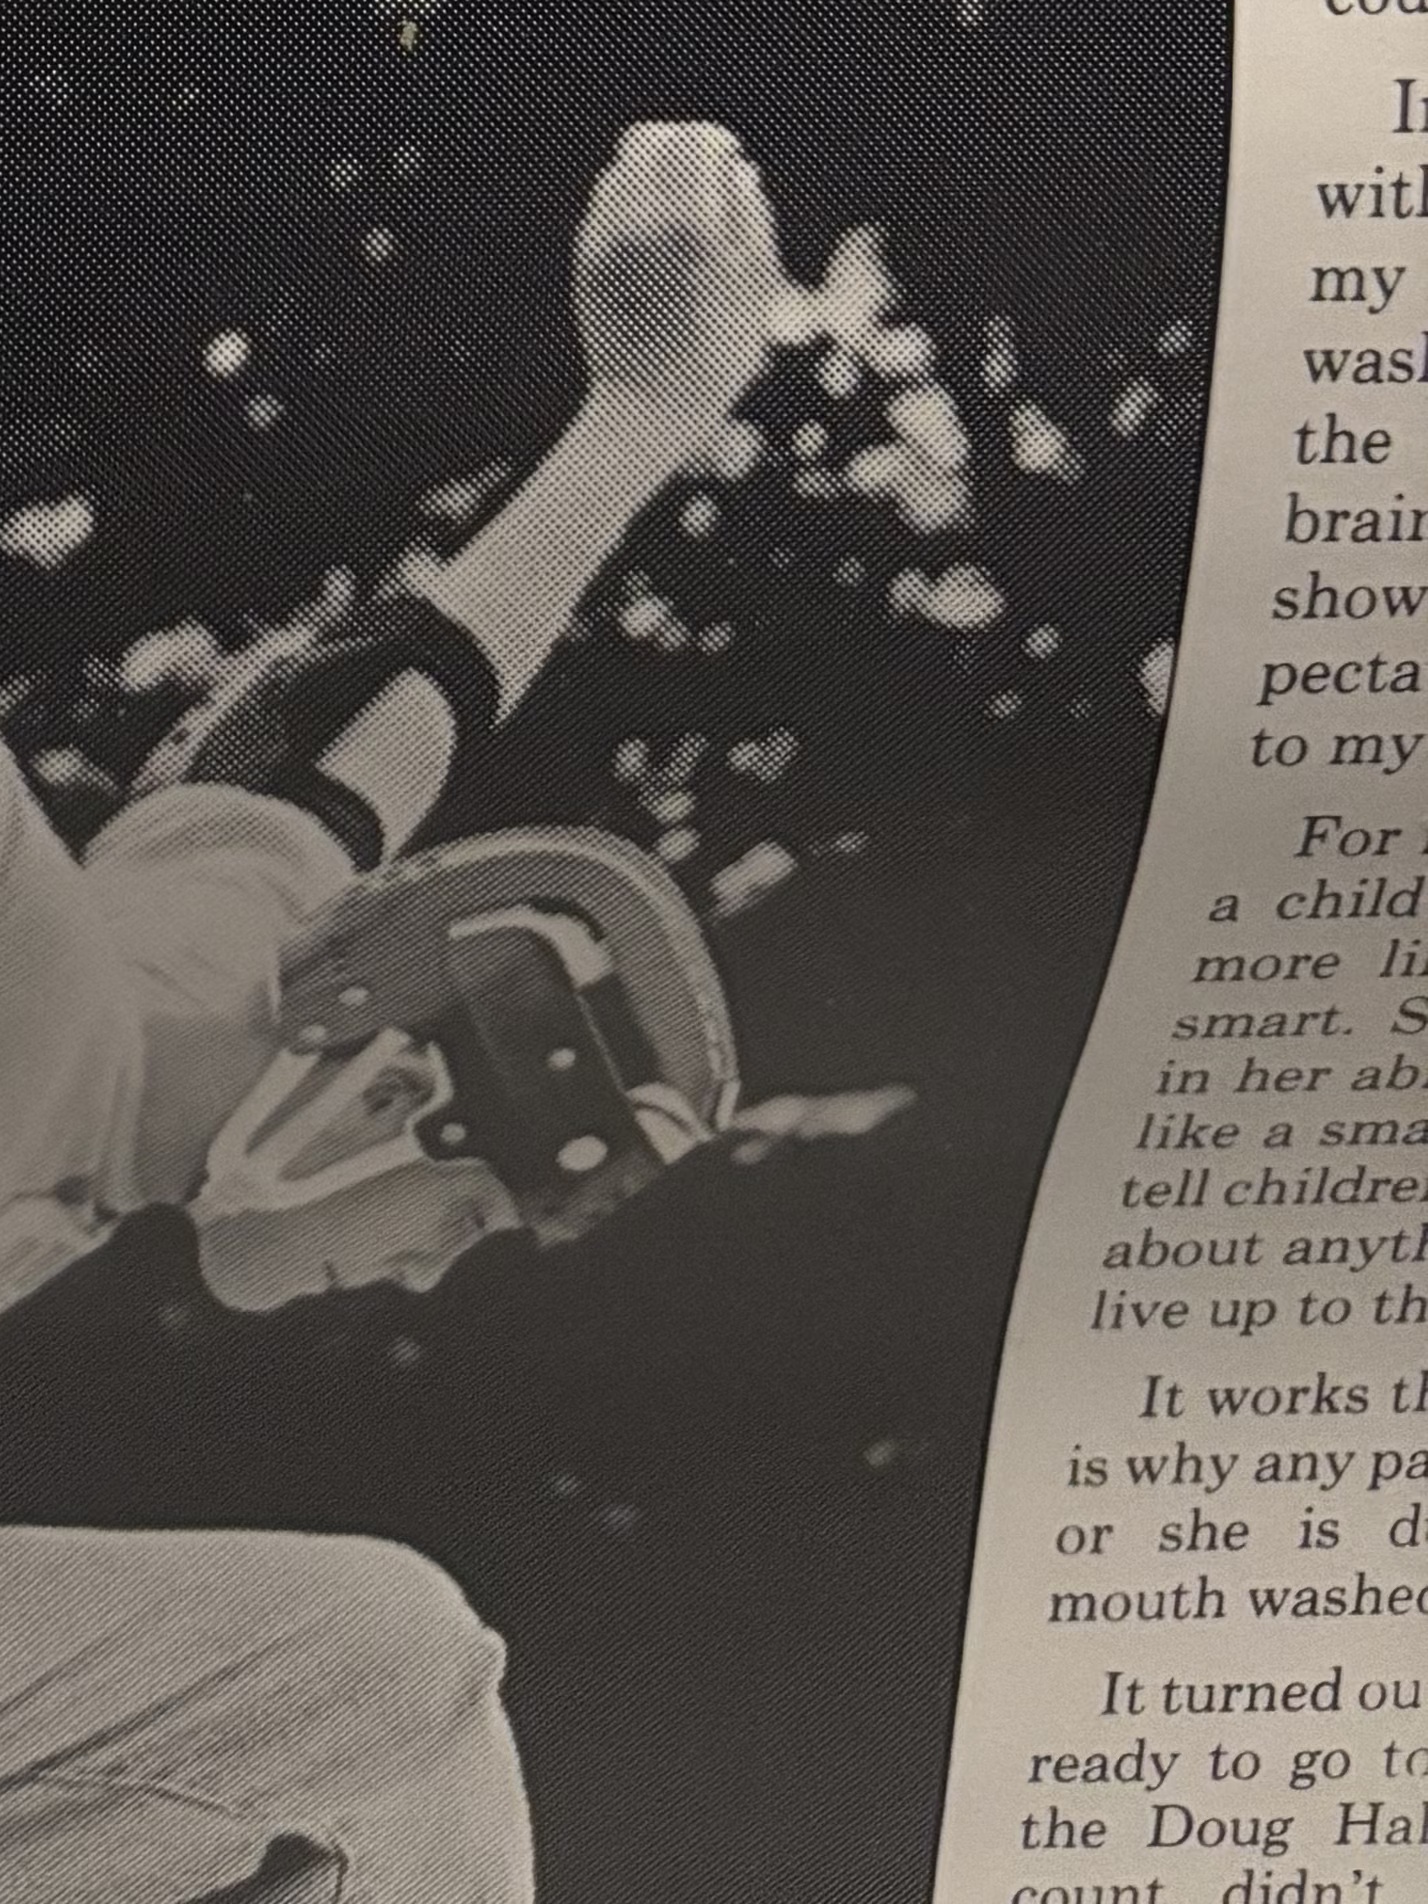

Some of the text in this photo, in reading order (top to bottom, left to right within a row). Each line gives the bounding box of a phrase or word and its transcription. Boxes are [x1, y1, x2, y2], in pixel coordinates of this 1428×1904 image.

[1308, 263, 1407, 315] my
[1294, 412, 1393, 465] the
[1251, 726, 1426, 776] to my
[1206, 875, 1426, 923] a child
[1089, 1289, 1191, 1333] live
[1210, 1296, 1278, 1338] up
[1298, 1290, 1353, 1327] to
[1067, 1444, 1109, 1488] is
[1126, 1440, 1240, 1494] why
[1253, 1451, 1357, 1492] any
[1102, 1672, 1145, 1715] It
[1162, 1666, 1343, 1715] turned
